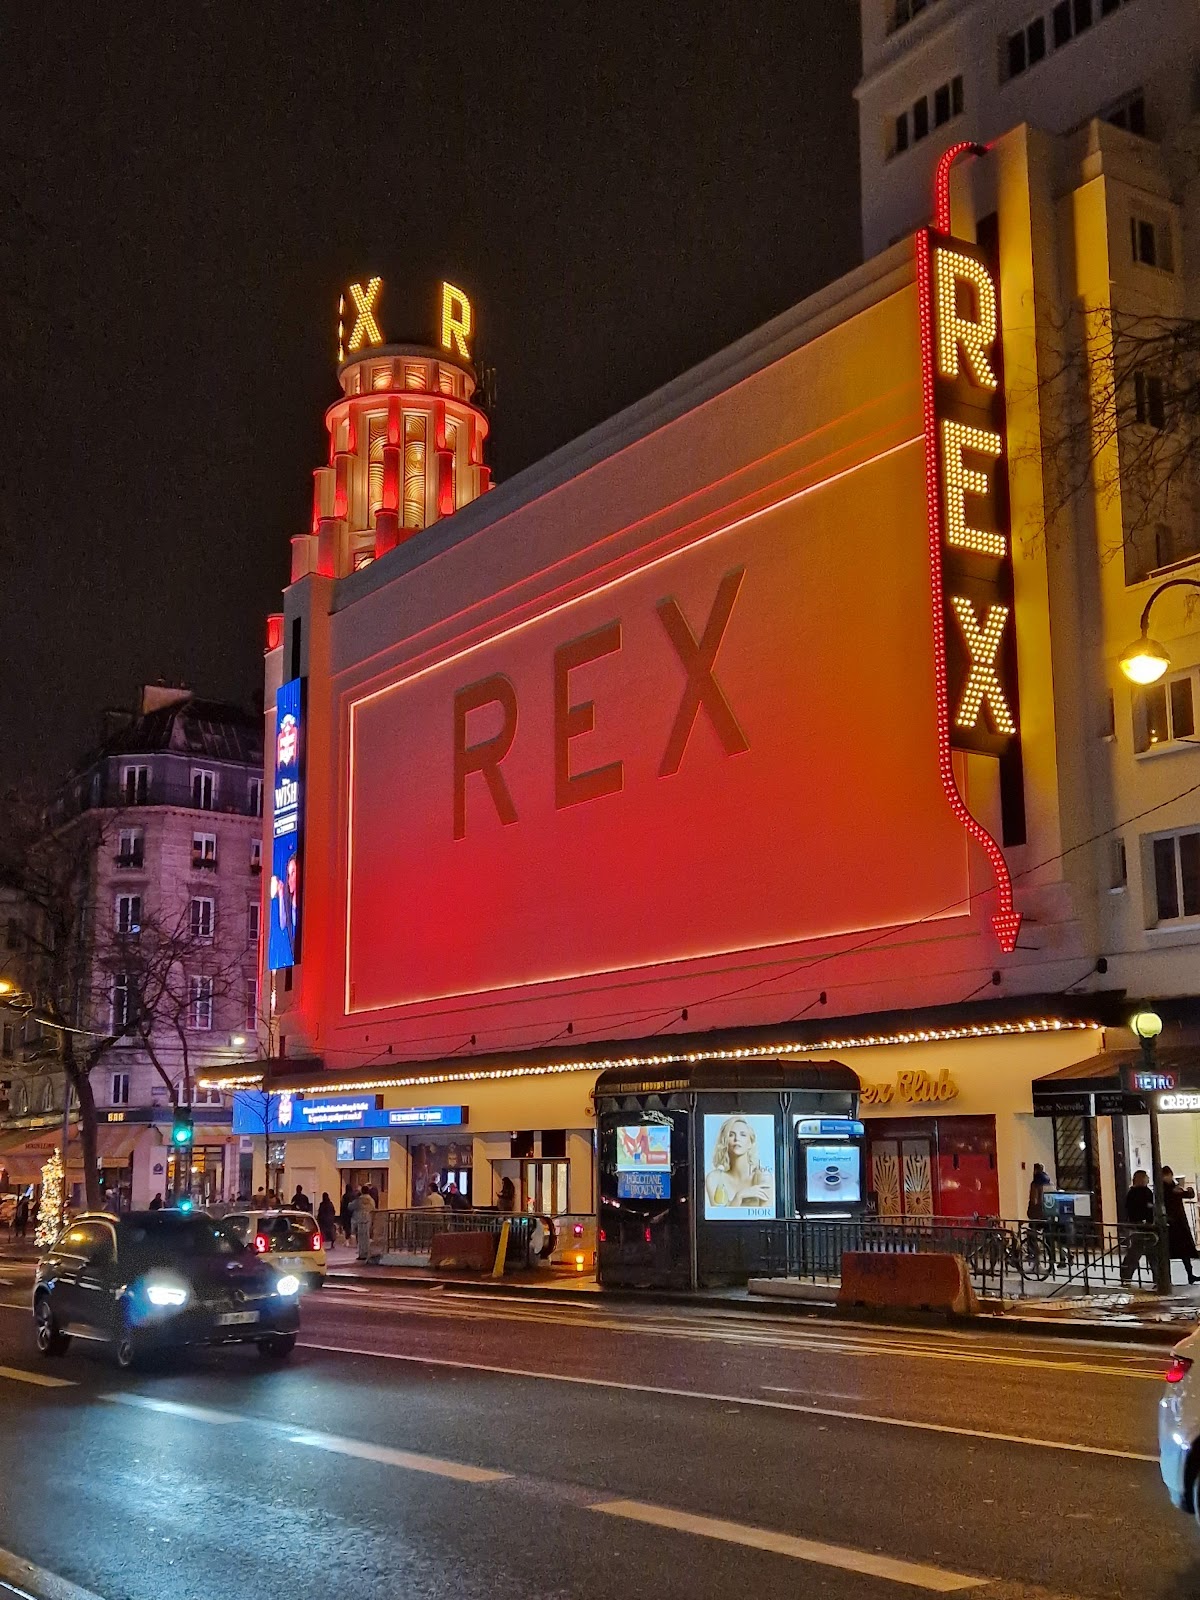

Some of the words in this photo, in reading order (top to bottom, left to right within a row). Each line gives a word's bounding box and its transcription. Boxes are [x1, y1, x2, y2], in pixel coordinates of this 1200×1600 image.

[348, 275, 383, 351] X
[441, 280, 472, 360] R
[936, 246, 1016, 736] REX
[453, 563, 750, 842] REX
[275, 781, 298, 809] WISH
[860, 1082, 895, 1104] ex
[896, 1068, 960, 1103] Club
[626, 1174, 662, 1185] L'OCCITANE
[630, 1185, 664, 1196] PROVENCE
[747, 1208, 771, 1217] DIOR
